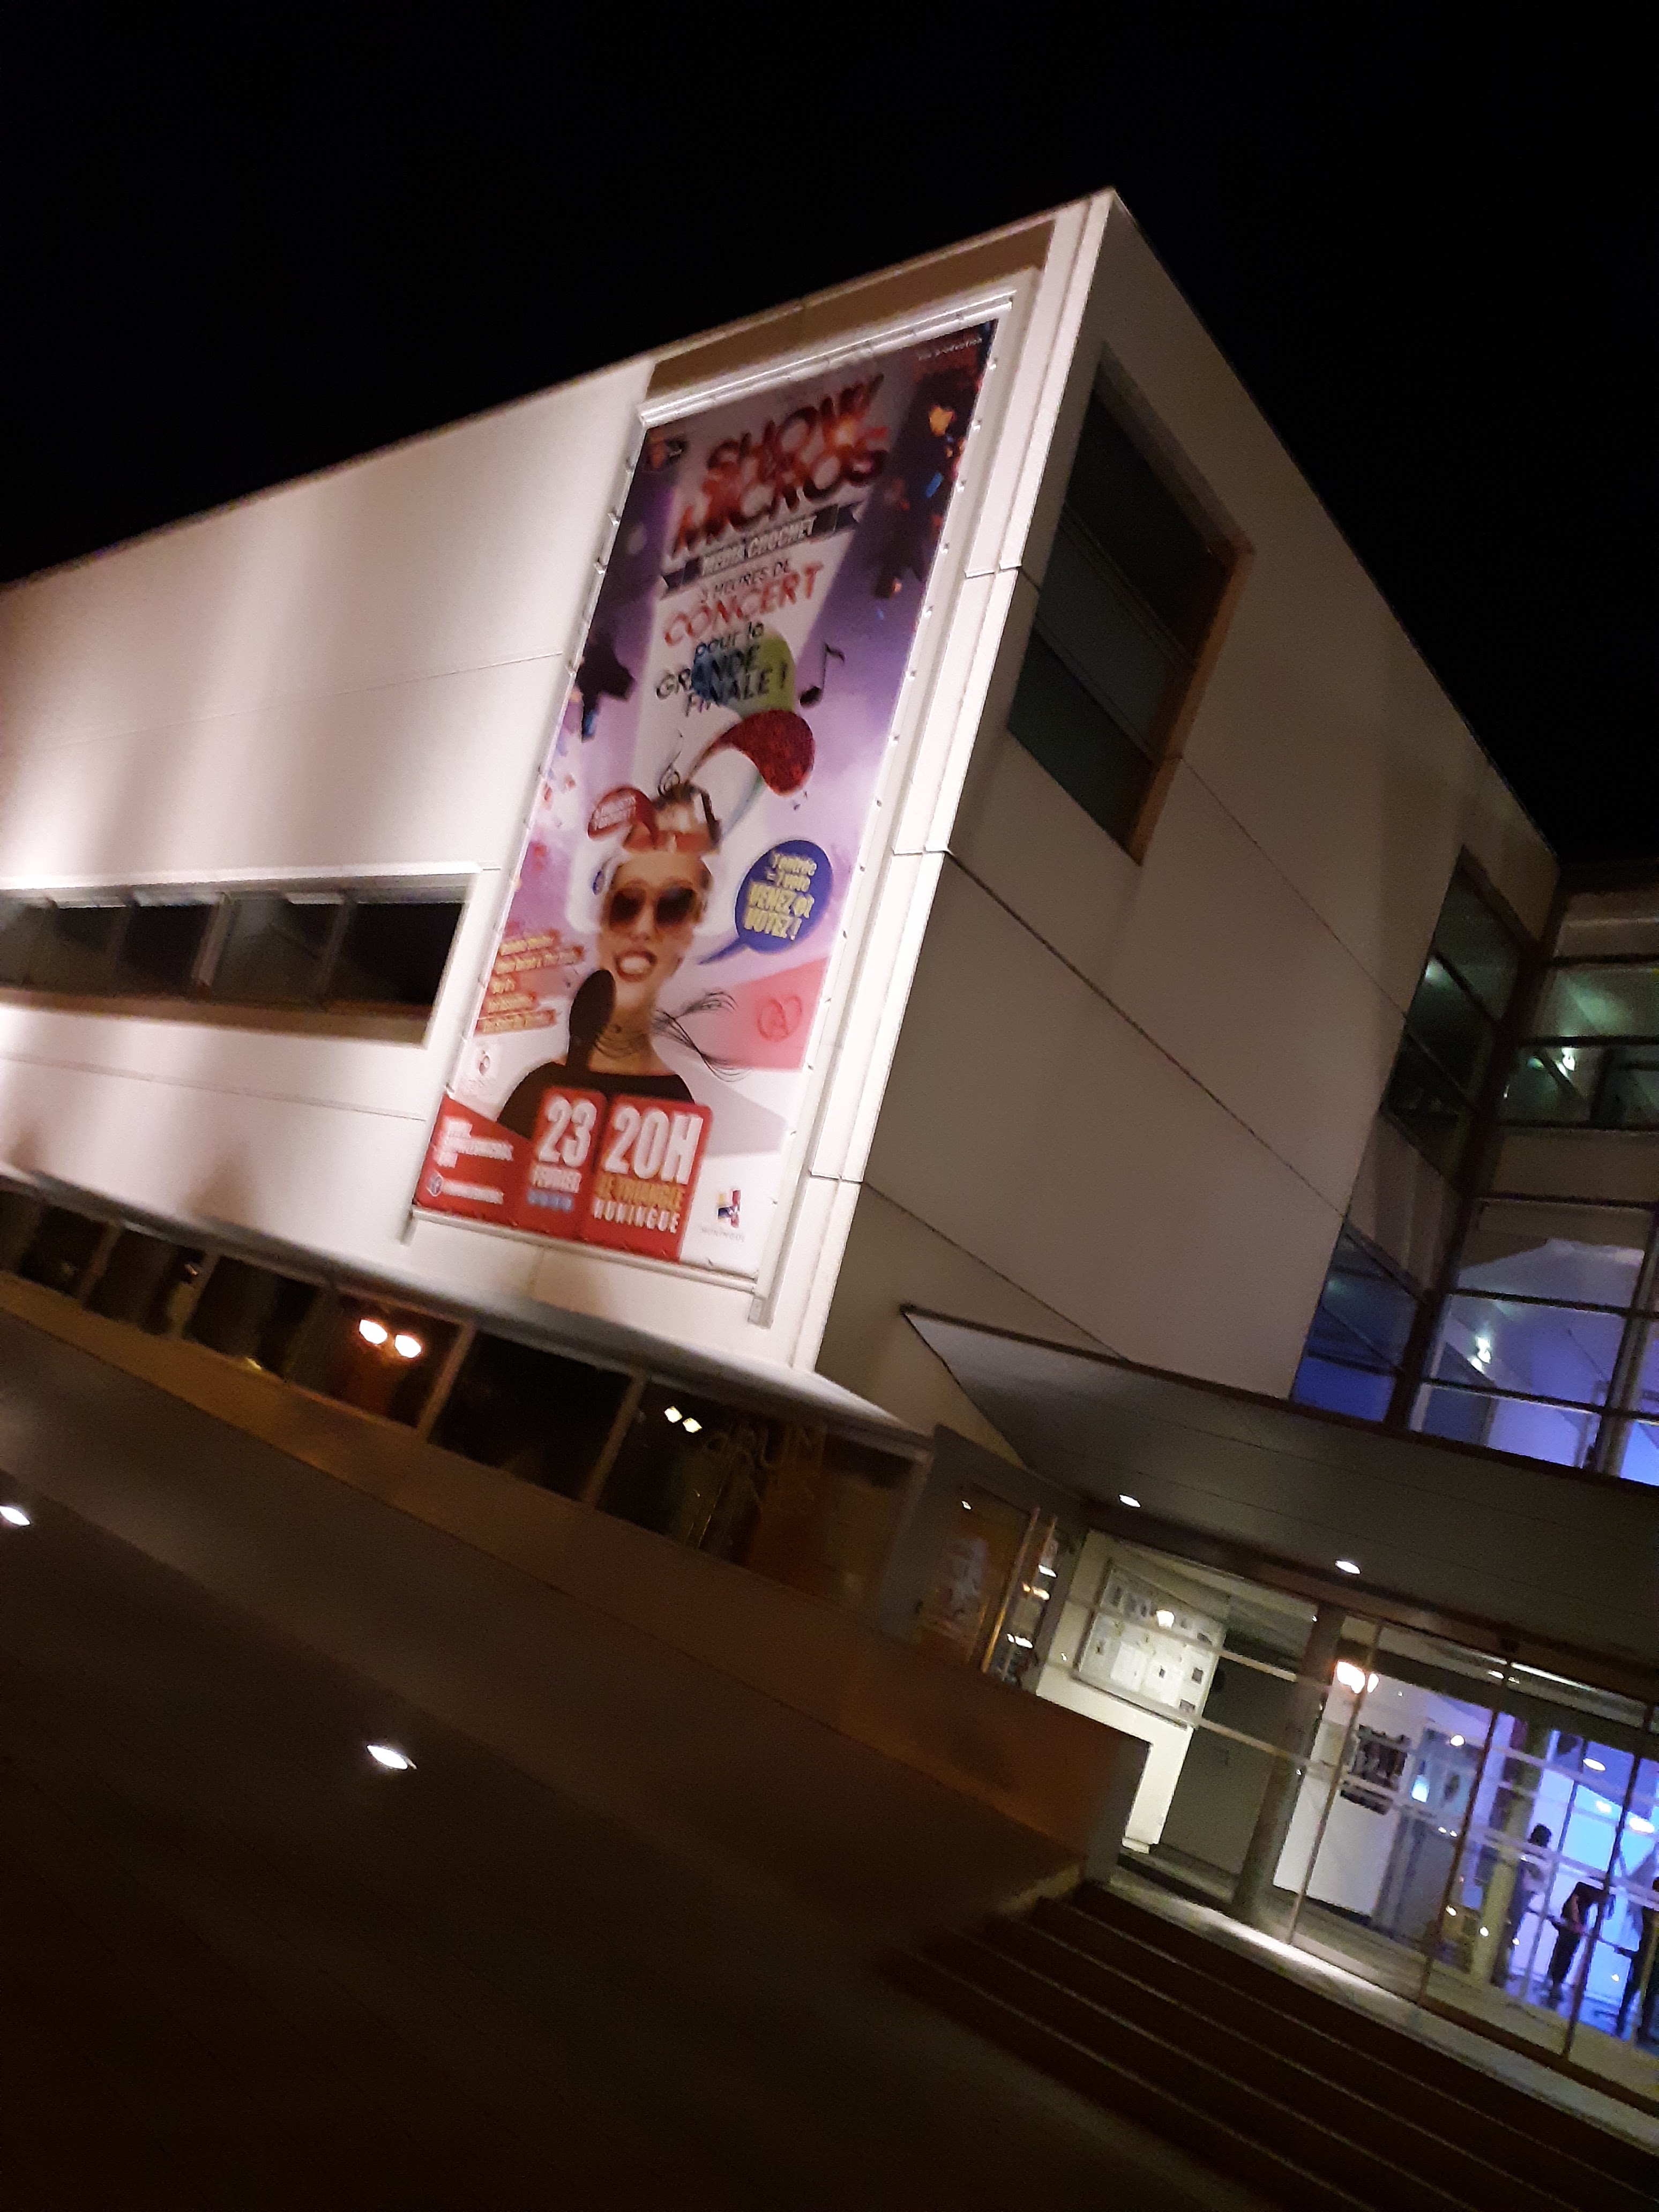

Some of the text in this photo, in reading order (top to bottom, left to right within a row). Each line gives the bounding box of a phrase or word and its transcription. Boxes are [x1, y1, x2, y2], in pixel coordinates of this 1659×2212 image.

[663, 561, 824, 647] CONCERT
[695, 619, 765, 659] pour la
[655, 642, 762, 701] GRANDE
[684, 668, 774, 718] FINALE
[748, 881, 797, 914] VENEZ
[743, 907, 794, 939] VOTEZ
[536, 1095, 597, 1168] 23
[603, 1105, 704, 1185] 20H
[593, 1195, 680, 1234] HUNINGUE
